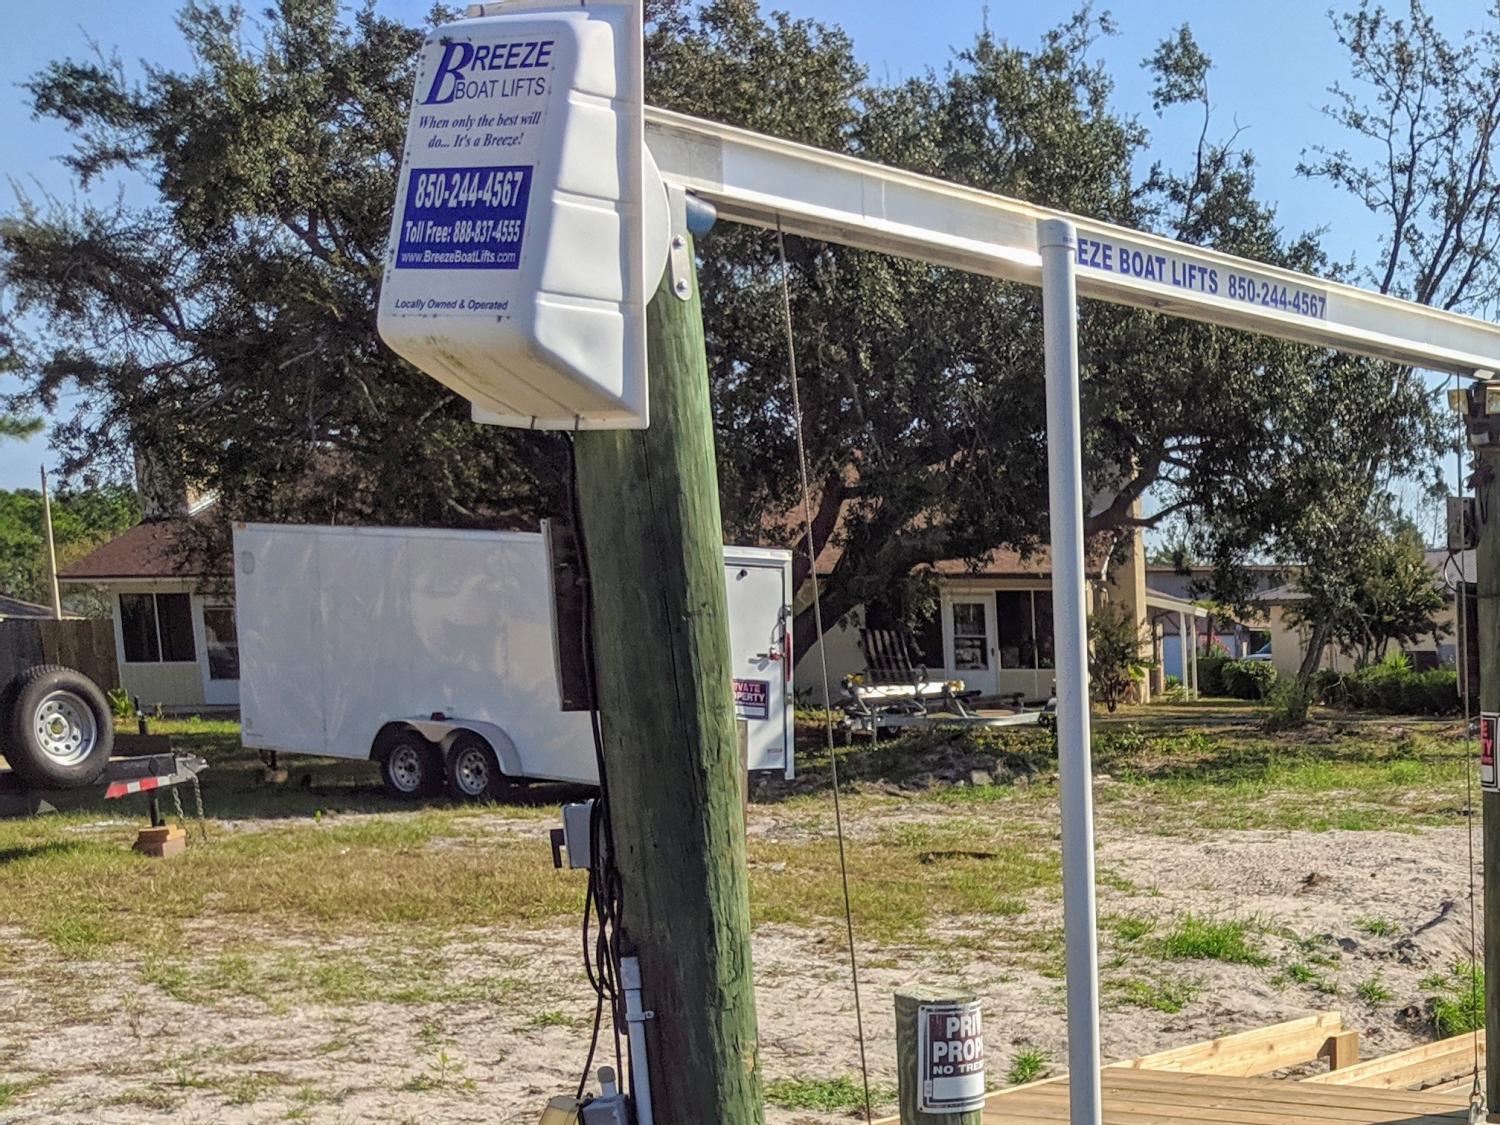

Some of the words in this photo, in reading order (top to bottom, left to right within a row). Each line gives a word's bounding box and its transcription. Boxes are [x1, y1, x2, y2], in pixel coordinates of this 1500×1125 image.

[420, 41, 554, 105] BREEZE
[455, 79, 498, 99] BOAT
[501, 77, 546, 97] LIFTS
[419, 115, 450, 129] When
[451, 114, 476, 131] only
[477, 114, 495, 127] the
[496, 113, 519, 127] best
[521, 111, 542, 125] will
[428, 135, 450, 148] do...
[453, 134, 471, 148] It's
[473, 137, 482, 147] a
[483, 132, 525, 147] Breeze!
[415, 171, 524, 208] 850-244-4567
[405, 220, 425, 243] Toll
[425, 220, 452, 243] Free:
[453, 220, 521, 243] 888-837-4555
[401, 249, 516, 263] www.BreezeBoatLifts.com
[1119, 247, 1166, 282] BOAT
[1172, 260, 1218, 294] LIFTS
[1228, 274, 1326, 319] 850-244-4567
[395, 298, 426, 311] Locally
[427, 299, 458, 309] Owned
[458, 299, 465, 309] &
[467, 299, 509, 311] Operated
[933, 1065, 954, 1075] NO
